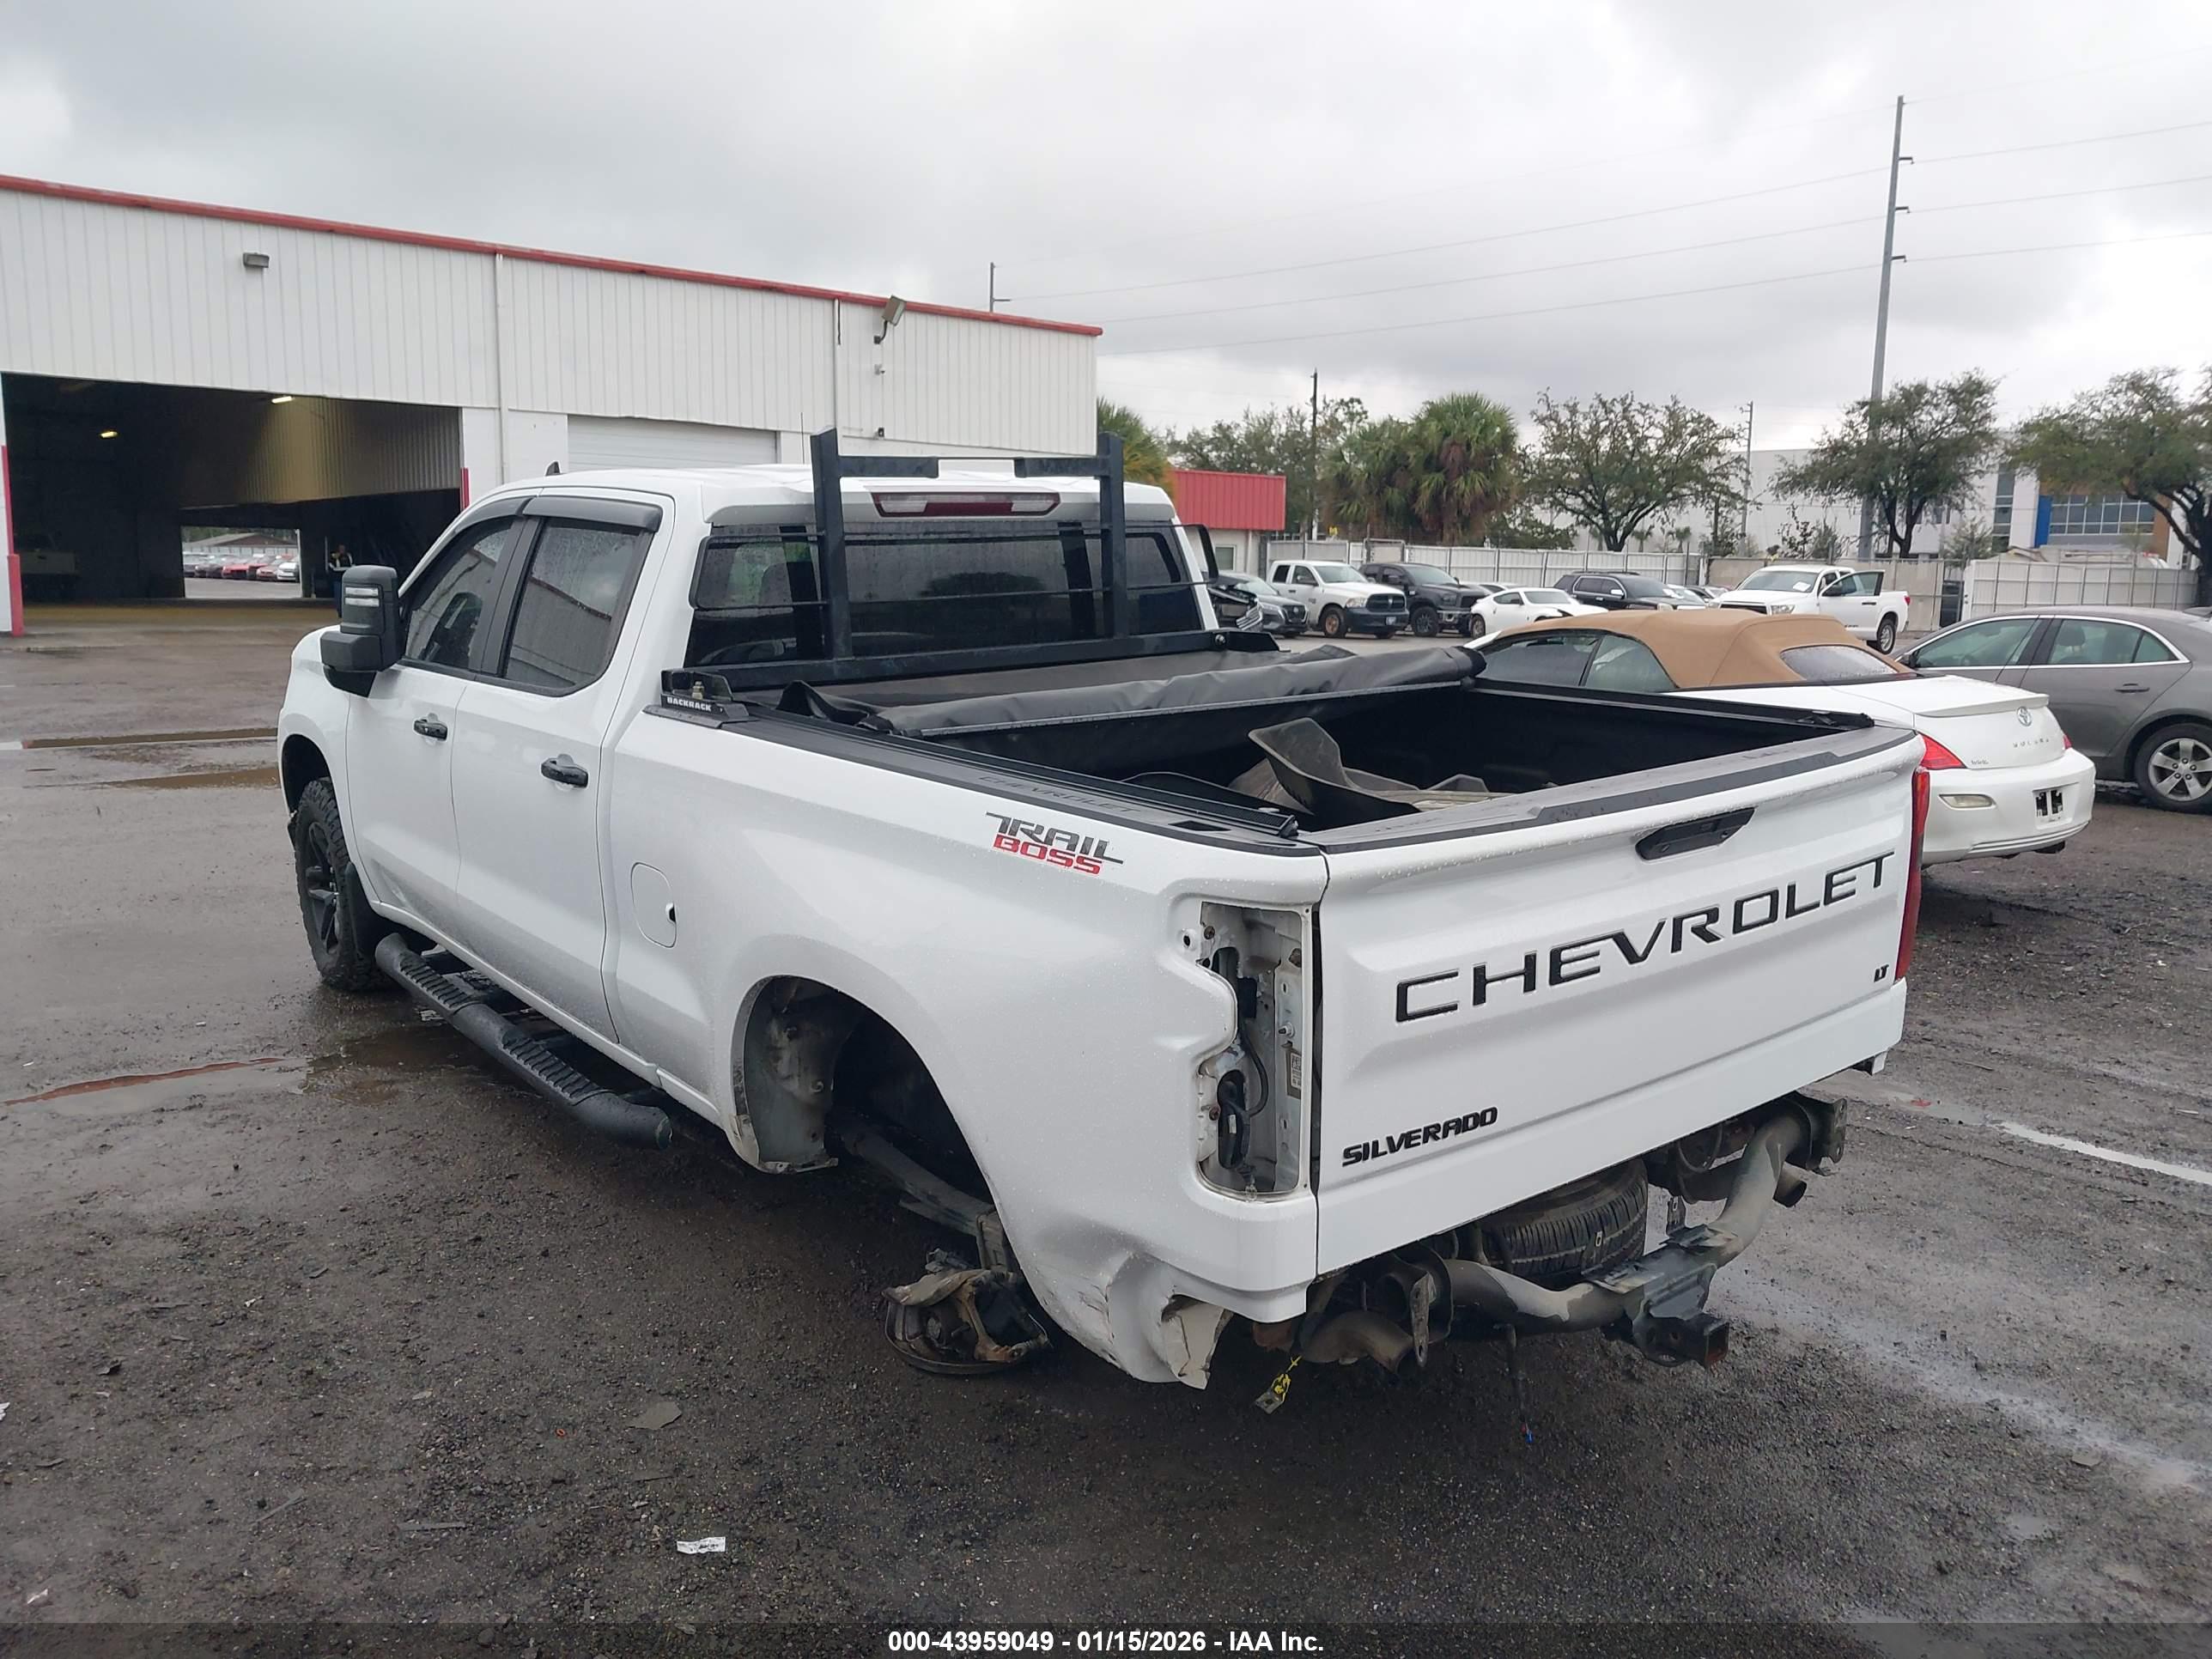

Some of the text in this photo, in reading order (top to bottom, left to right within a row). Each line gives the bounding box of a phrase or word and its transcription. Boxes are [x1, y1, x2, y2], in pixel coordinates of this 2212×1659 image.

[666, 696, 712, 712] BACKRACK
[986, 811, 1124, 865] TRAIL
[993, 833, 1103, 875] BOSS
[1395, 850, 1896, 1023] CHEVROLET
[1873, 963, 1890, 983] LT
[1341, 1106, 1498, 1167] SILVERADO
